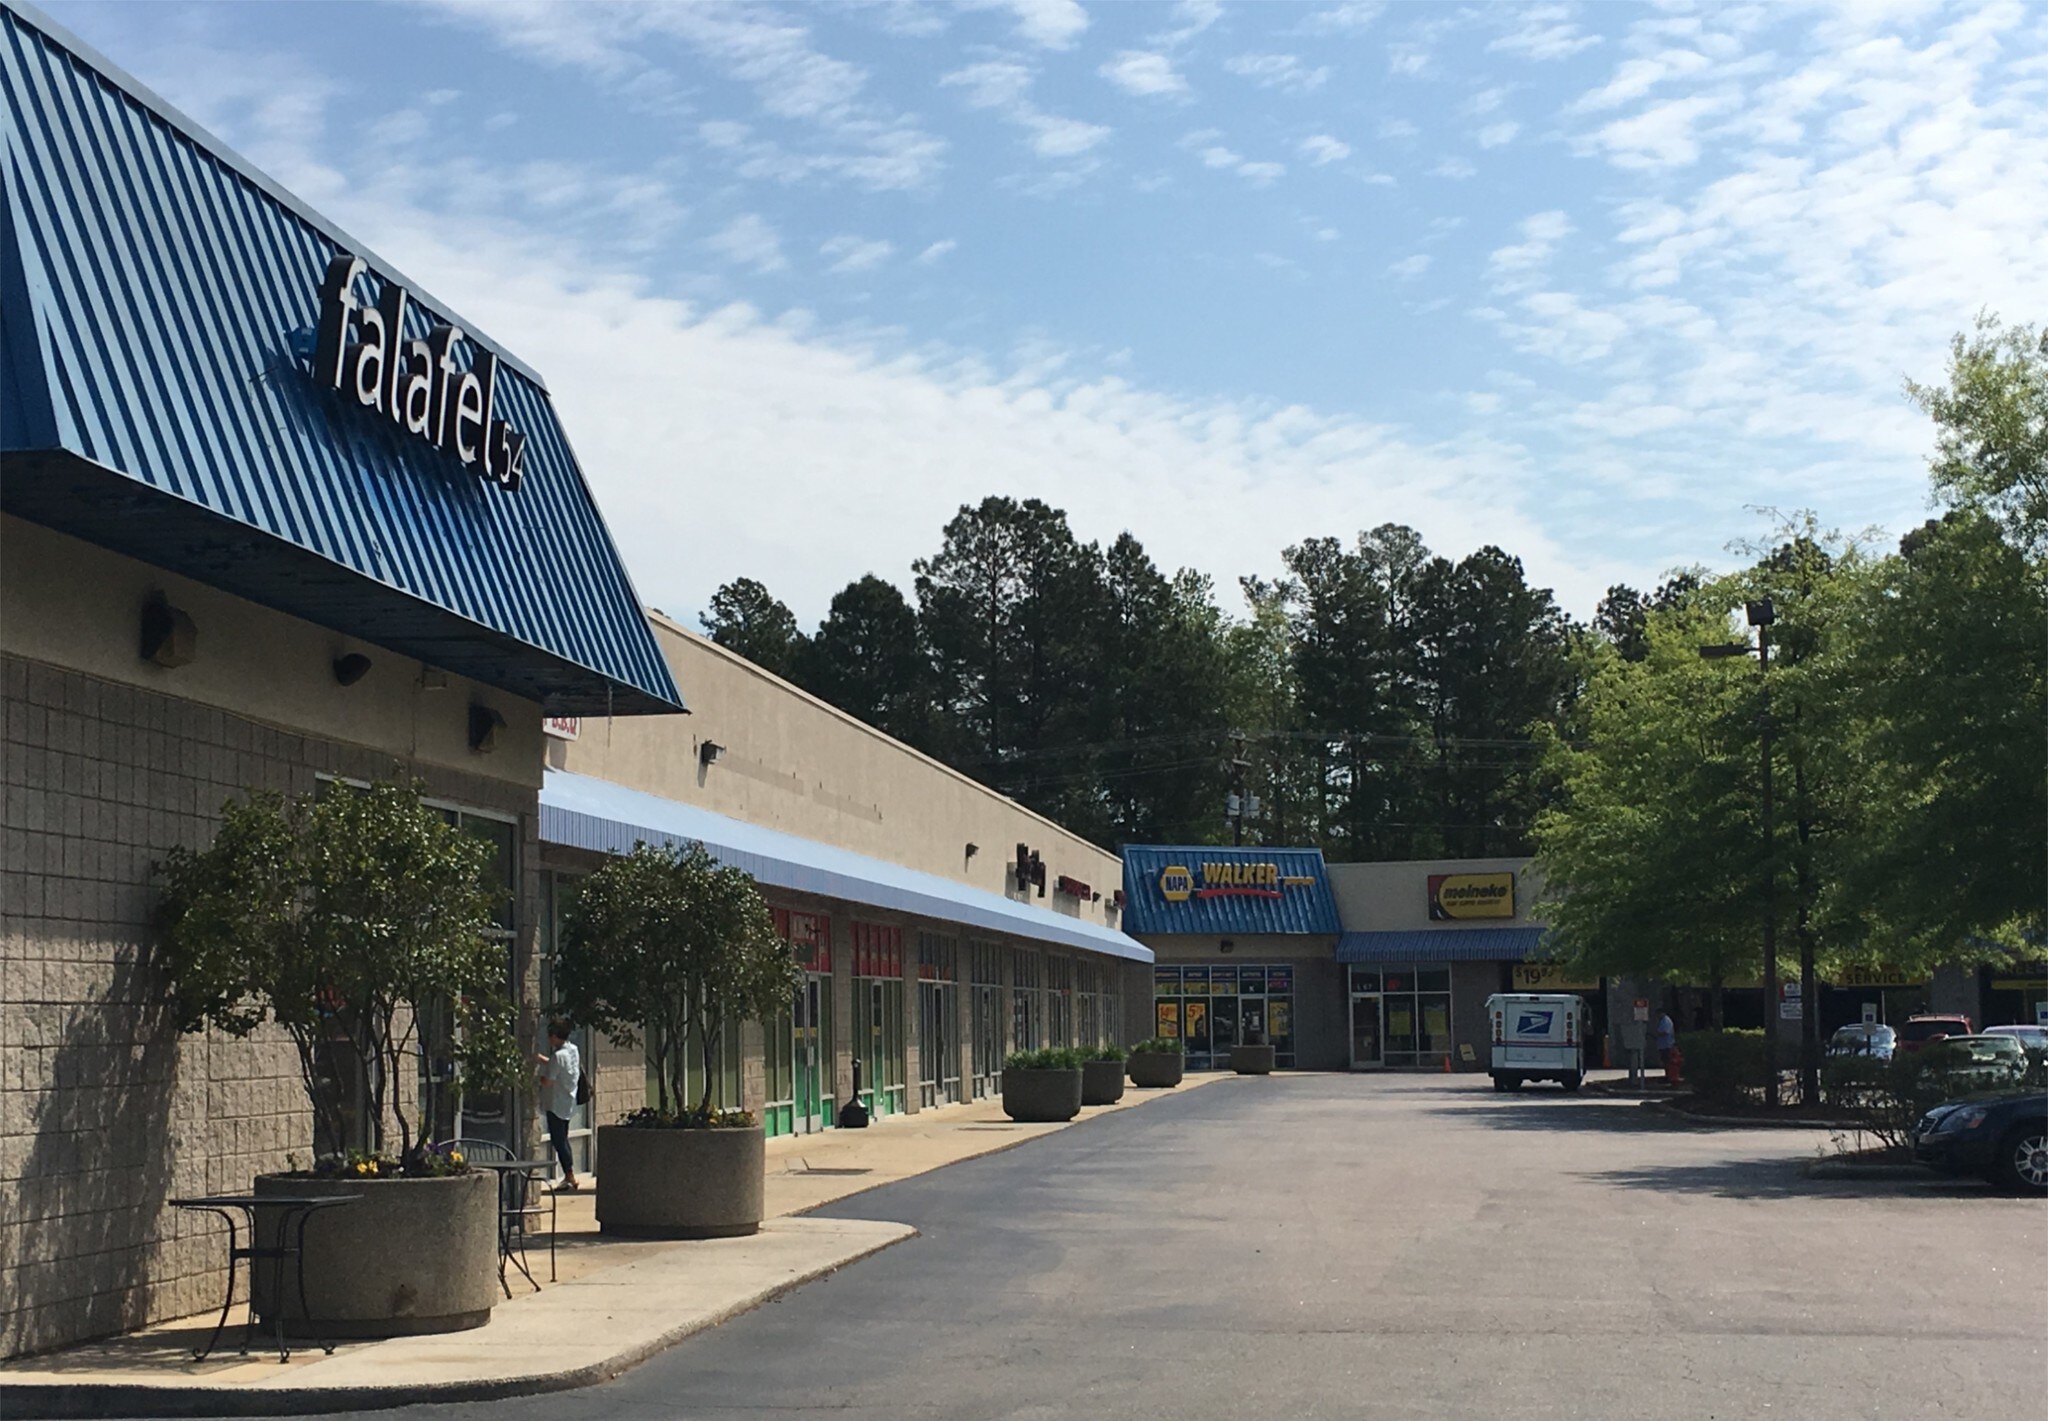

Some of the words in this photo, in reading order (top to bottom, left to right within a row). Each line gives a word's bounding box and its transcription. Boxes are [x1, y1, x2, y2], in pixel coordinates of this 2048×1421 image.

[336, 255, 500, 478] falafel
[500, 421, 528, 493] 54
[1165, 876, 1189, 892] NAPA
[1202, 863, 1278, 885] WALKER
[1443, 884, 1507, 899] meineke
[1846, 973, 1907, 985] SERVICE
